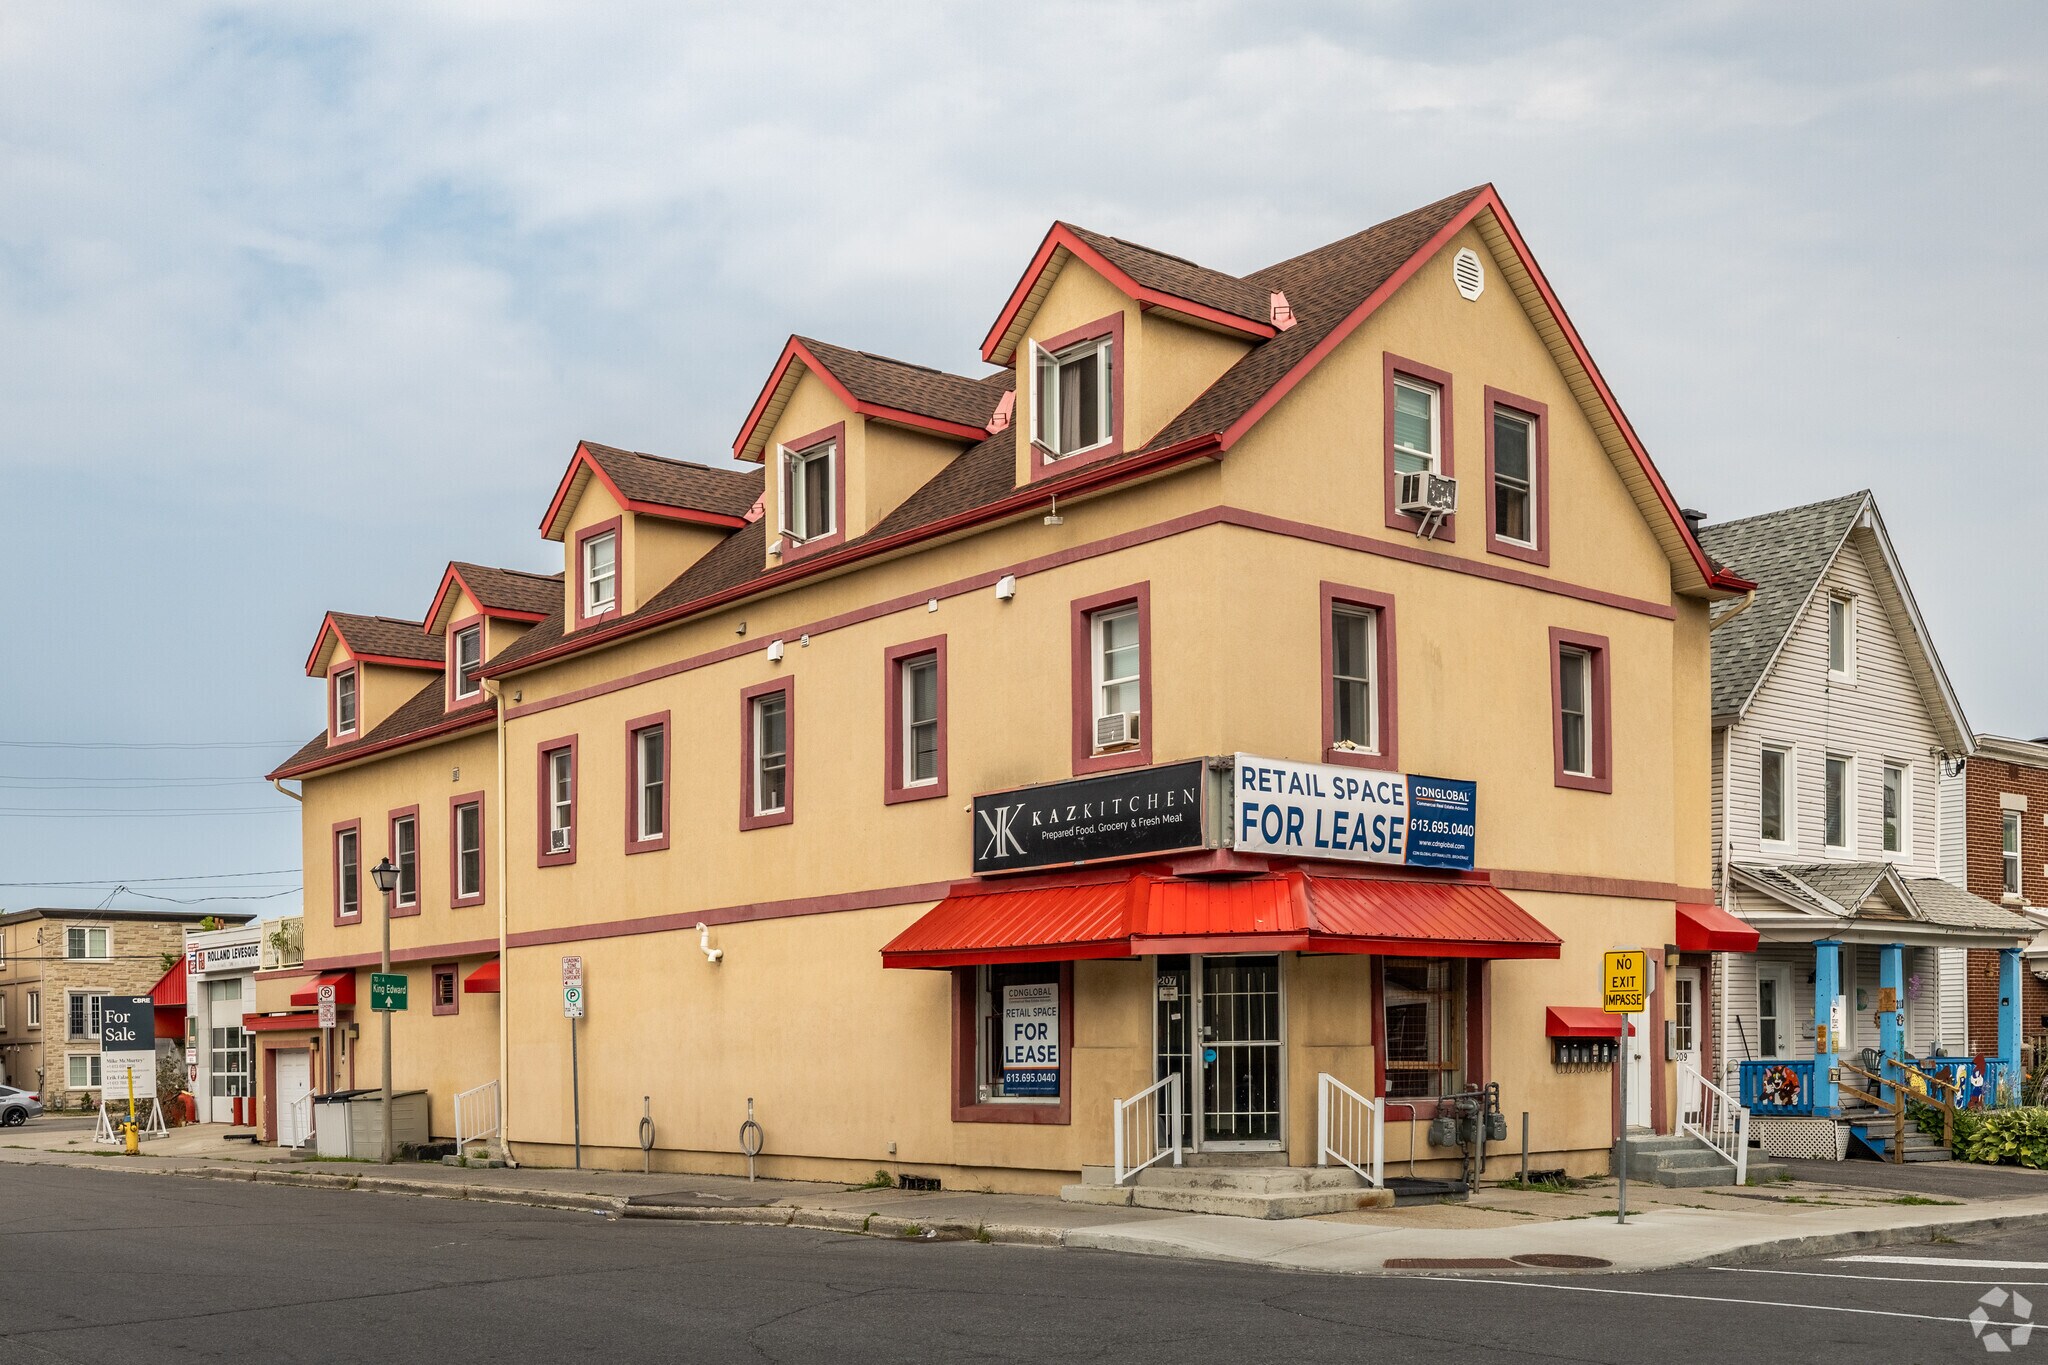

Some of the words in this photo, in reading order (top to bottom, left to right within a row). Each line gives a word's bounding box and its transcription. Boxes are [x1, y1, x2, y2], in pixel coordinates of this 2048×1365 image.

[1242, 766, 1326, 798] RETAIL
[1332, 776, 1404, 806] SPACE
[1416, 786, 1469, 802] CDNGLOBAL
[1042, 826, 1074, 840] Prepared
[1098, 820, 1128, 833] Grocery
[1131, 819, 1137, 828] &
[1139, 815, 1160, 827] Fresh
[1162, 813, 1182, 824] Meat
[1242, 802, 1304, 846] FOR
[1315, 809, 1404, 854] LEASE
[1410, 819, 1474, 837] 613.695.0440
[208, 949, 230, 962] ROLLAND
[232, 946, 258, 959] LEVESQUE
[1616, 959, 1632, 970] NO
[1158, 976, 1176, 985] 207
[1612, 976, 1636, 988] EXIT
[373, 984, 385, 995] King
[386, 985, 407, 994] Edward
[1009, 988, 1051, 997] CDNGLOBAL
[1605, 994, 1642, 1006] IMPASSE
[105, 1010, 130, 1023] For
[1006, 1008, 1030, 1018] RETAIL
[1033, 1007, 1056, 1016] SPACE
[106, 1027, 136, 1041] Sale
[1015, 1023, 1048, 1040] FOR
[1006, 1045, 1056, 1063] LEASE
[1676, 1053, 1687, 1061] 209
[1006, 1073, 1056, 1083] 613.695.0440
